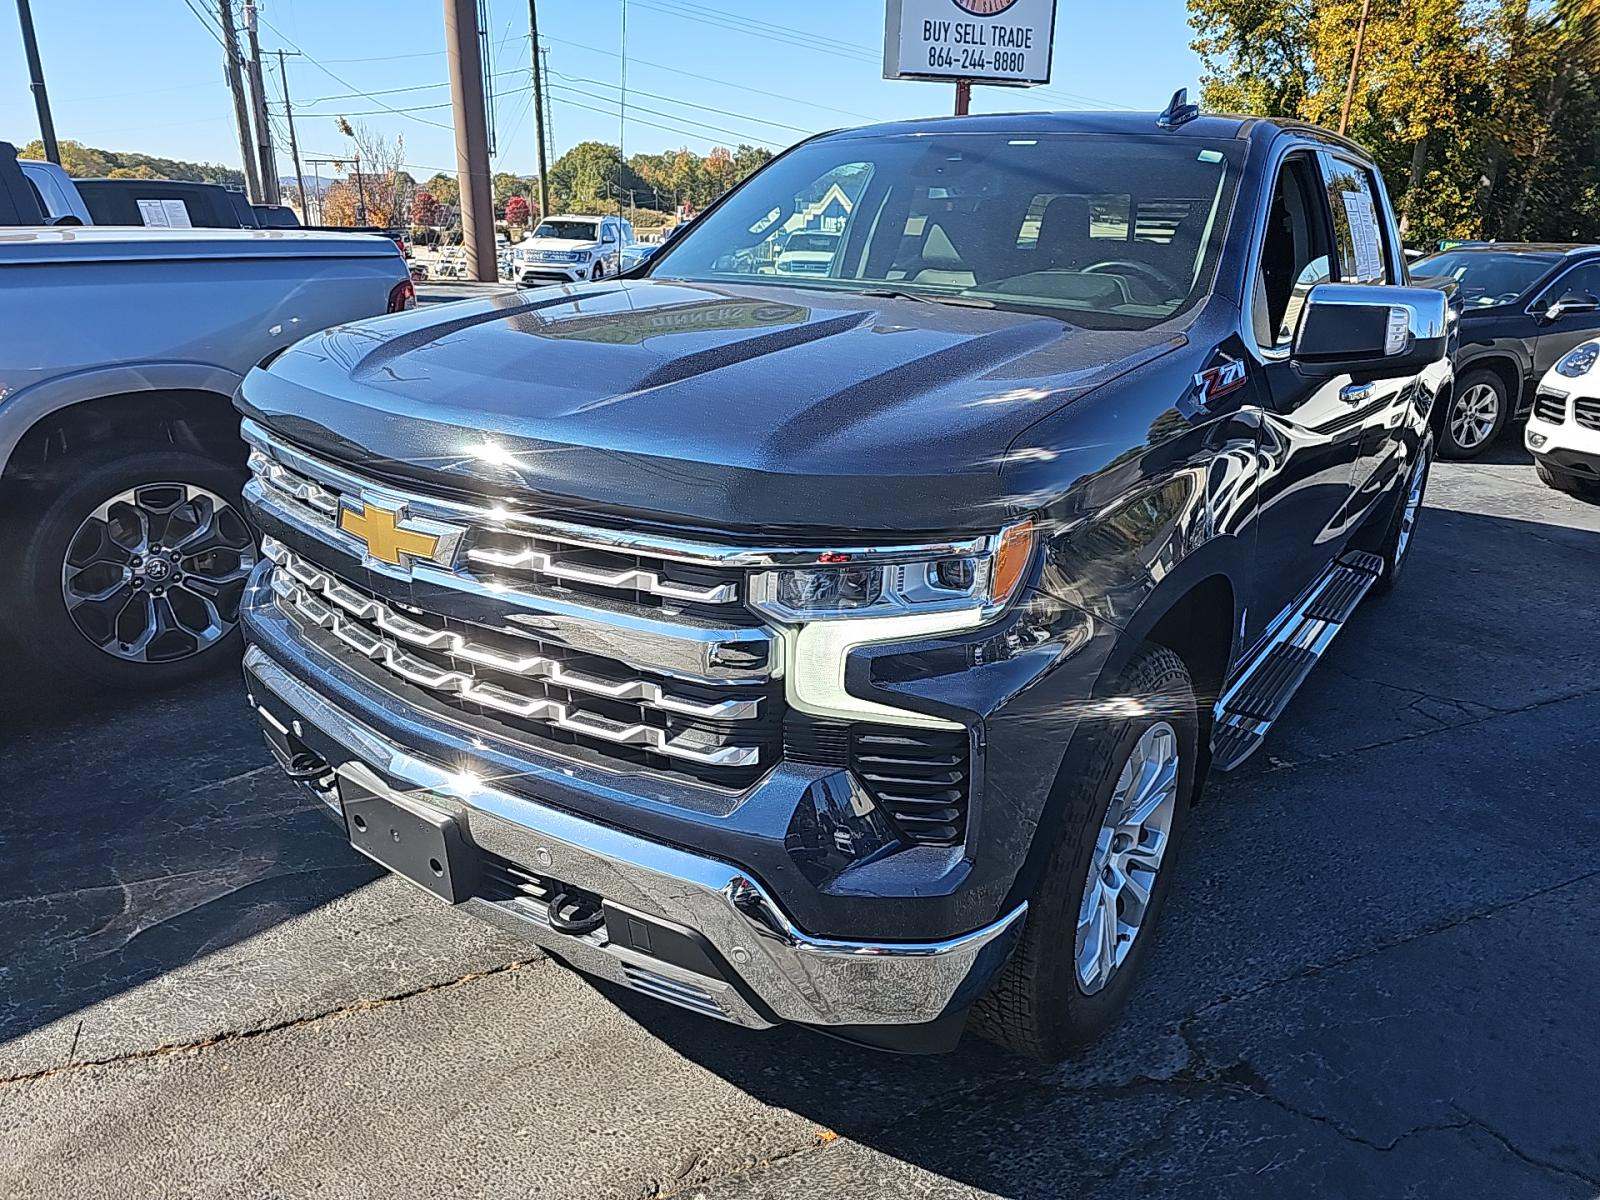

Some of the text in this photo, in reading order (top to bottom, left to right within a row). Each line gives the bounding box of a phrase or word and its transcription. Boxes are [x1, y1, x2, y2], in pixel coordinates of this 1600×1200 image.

[923, 19, 1033, 49] BUY SELL TRADE
[928, 46, 1025, 73] 864-244-8880
[1193, 358, 1247, 405] Z71
